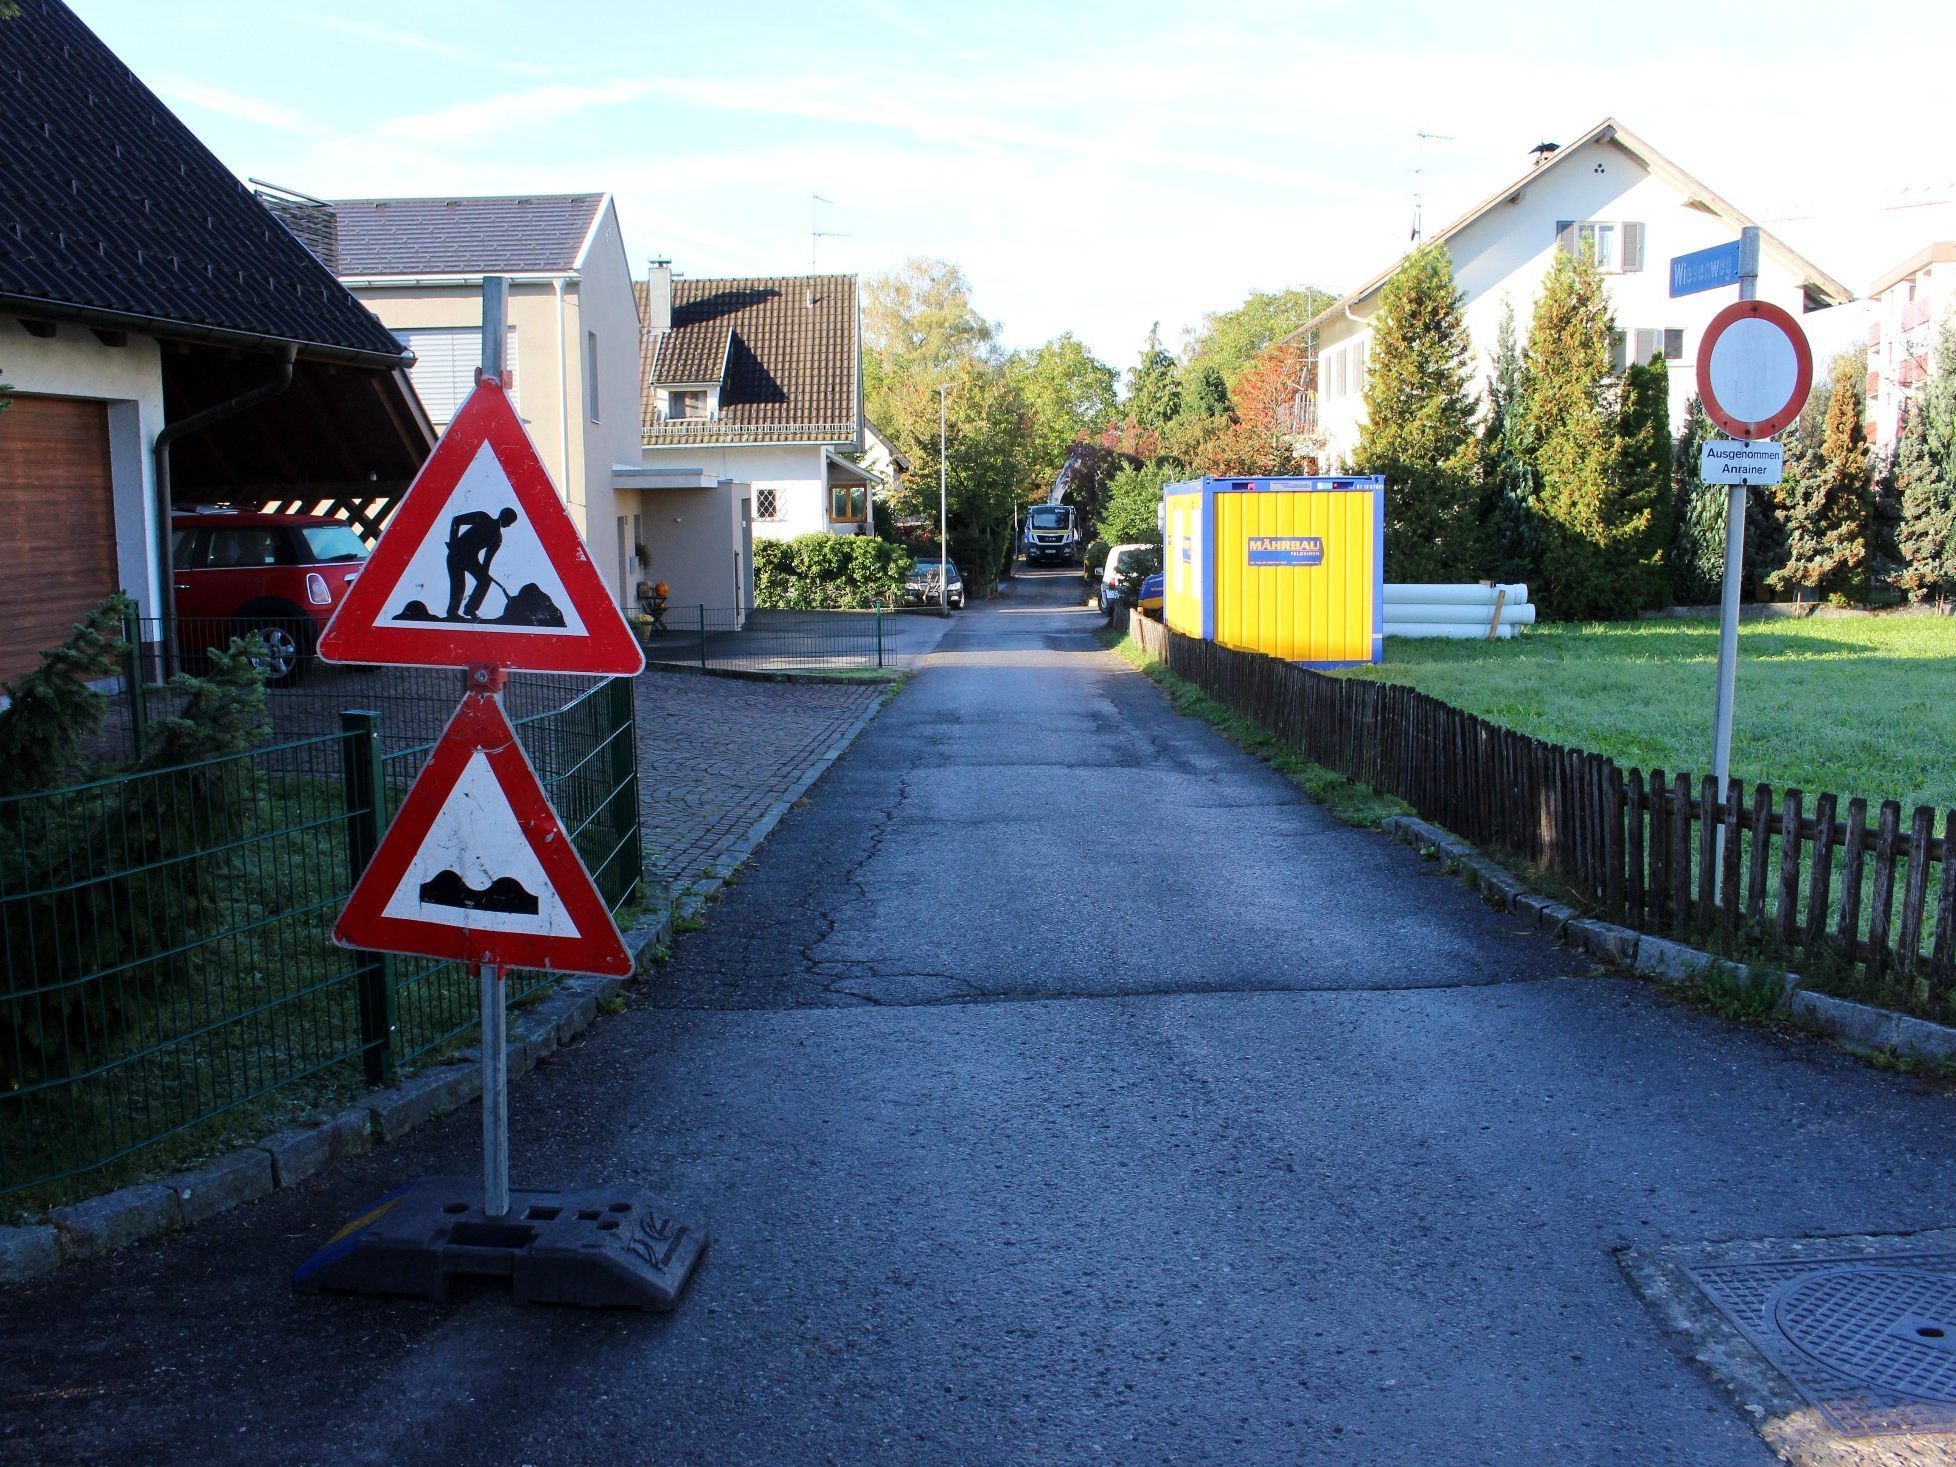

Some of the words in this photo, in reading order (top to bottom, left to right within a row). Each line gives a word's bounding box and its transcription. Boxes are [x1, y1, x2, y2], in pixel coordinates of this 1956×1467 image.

[1674, 257, 1732, 287] Wiesenweg
[1707, 448, 1780, 460] Ausgenommen
[1722, 463, 1767, 474] Anrainer
[1249, 539, 1320, 551] MÄHRBAU
